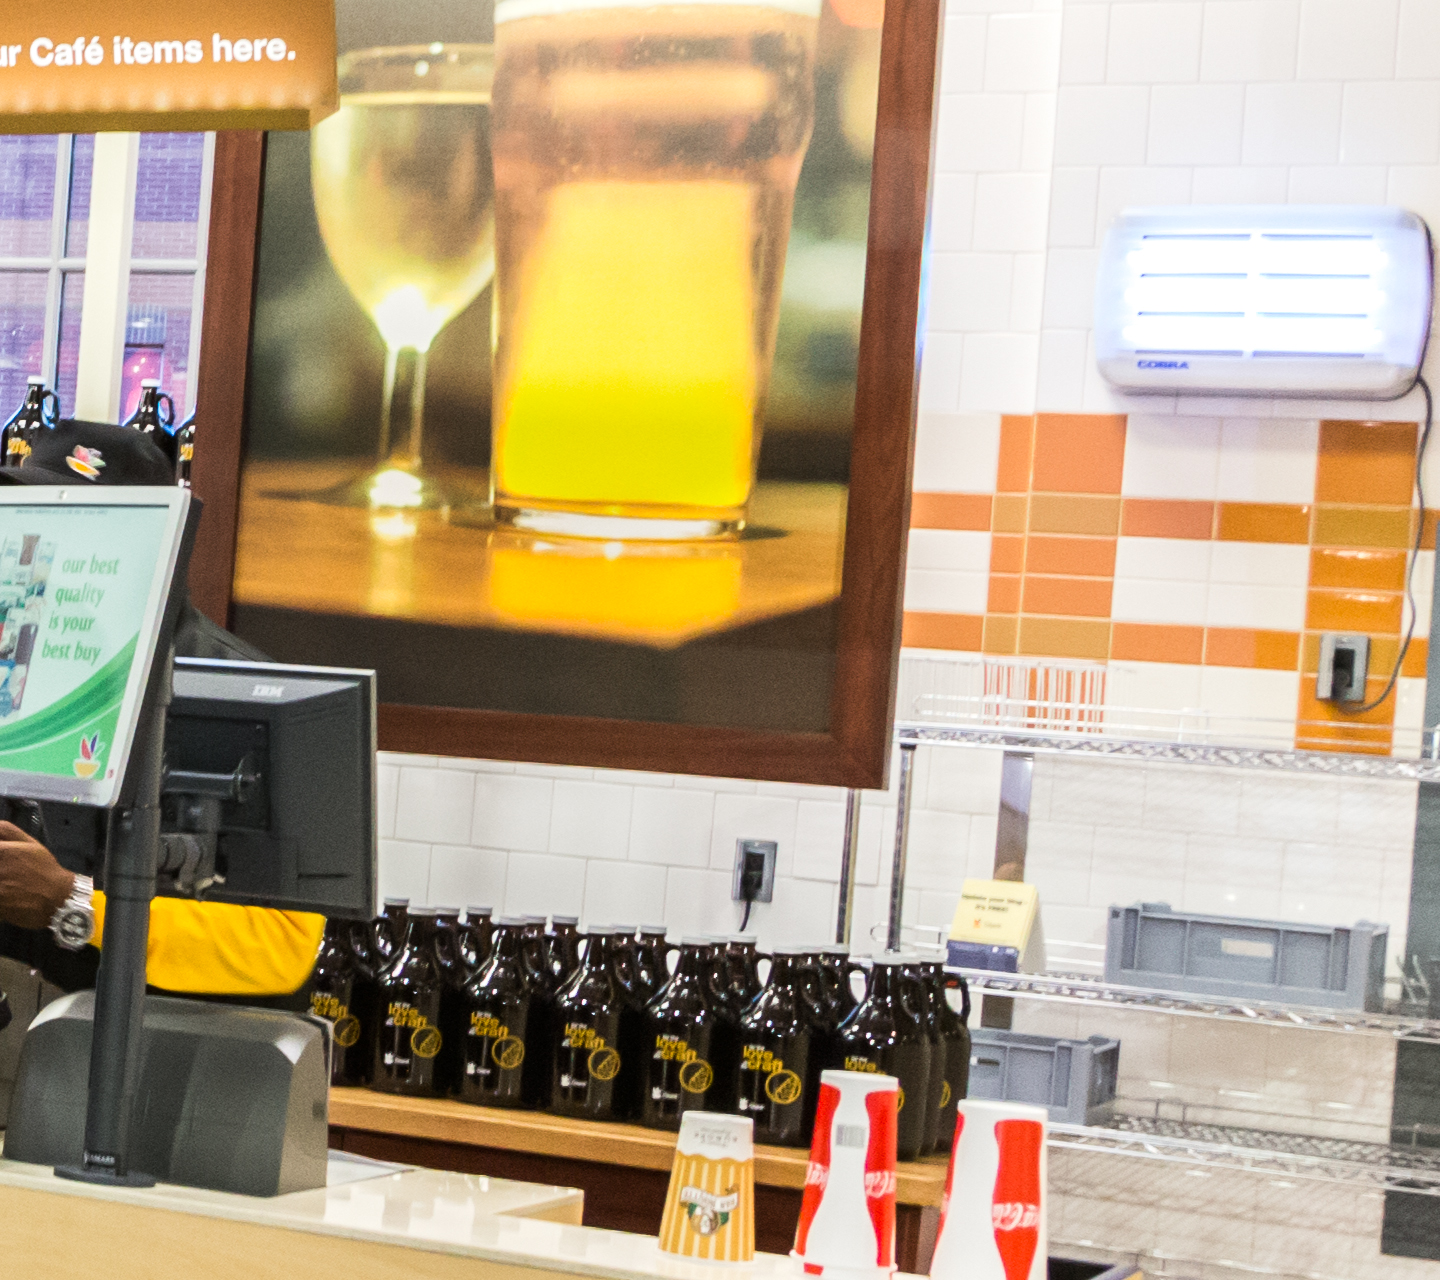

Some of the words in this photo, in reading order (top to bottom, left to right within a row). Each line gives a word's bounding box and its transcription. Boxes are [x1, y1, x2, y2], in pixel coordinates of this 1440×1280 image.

[30, 34, 104, 67] Café
[113, 36, 203, 66] items
[210, 32, 296, 64] here.
[1137, 360, 1190, 370] COBRA
[62, 558, 86, 575] our
[90, 555, 120, 575] best
[55, 583, 105, 607] quality
[48, 613, 60, 629] is
[62, 614, 95, 634] your
[41, 639, 71, 659] best
[74, 641, 102, 666] buy
